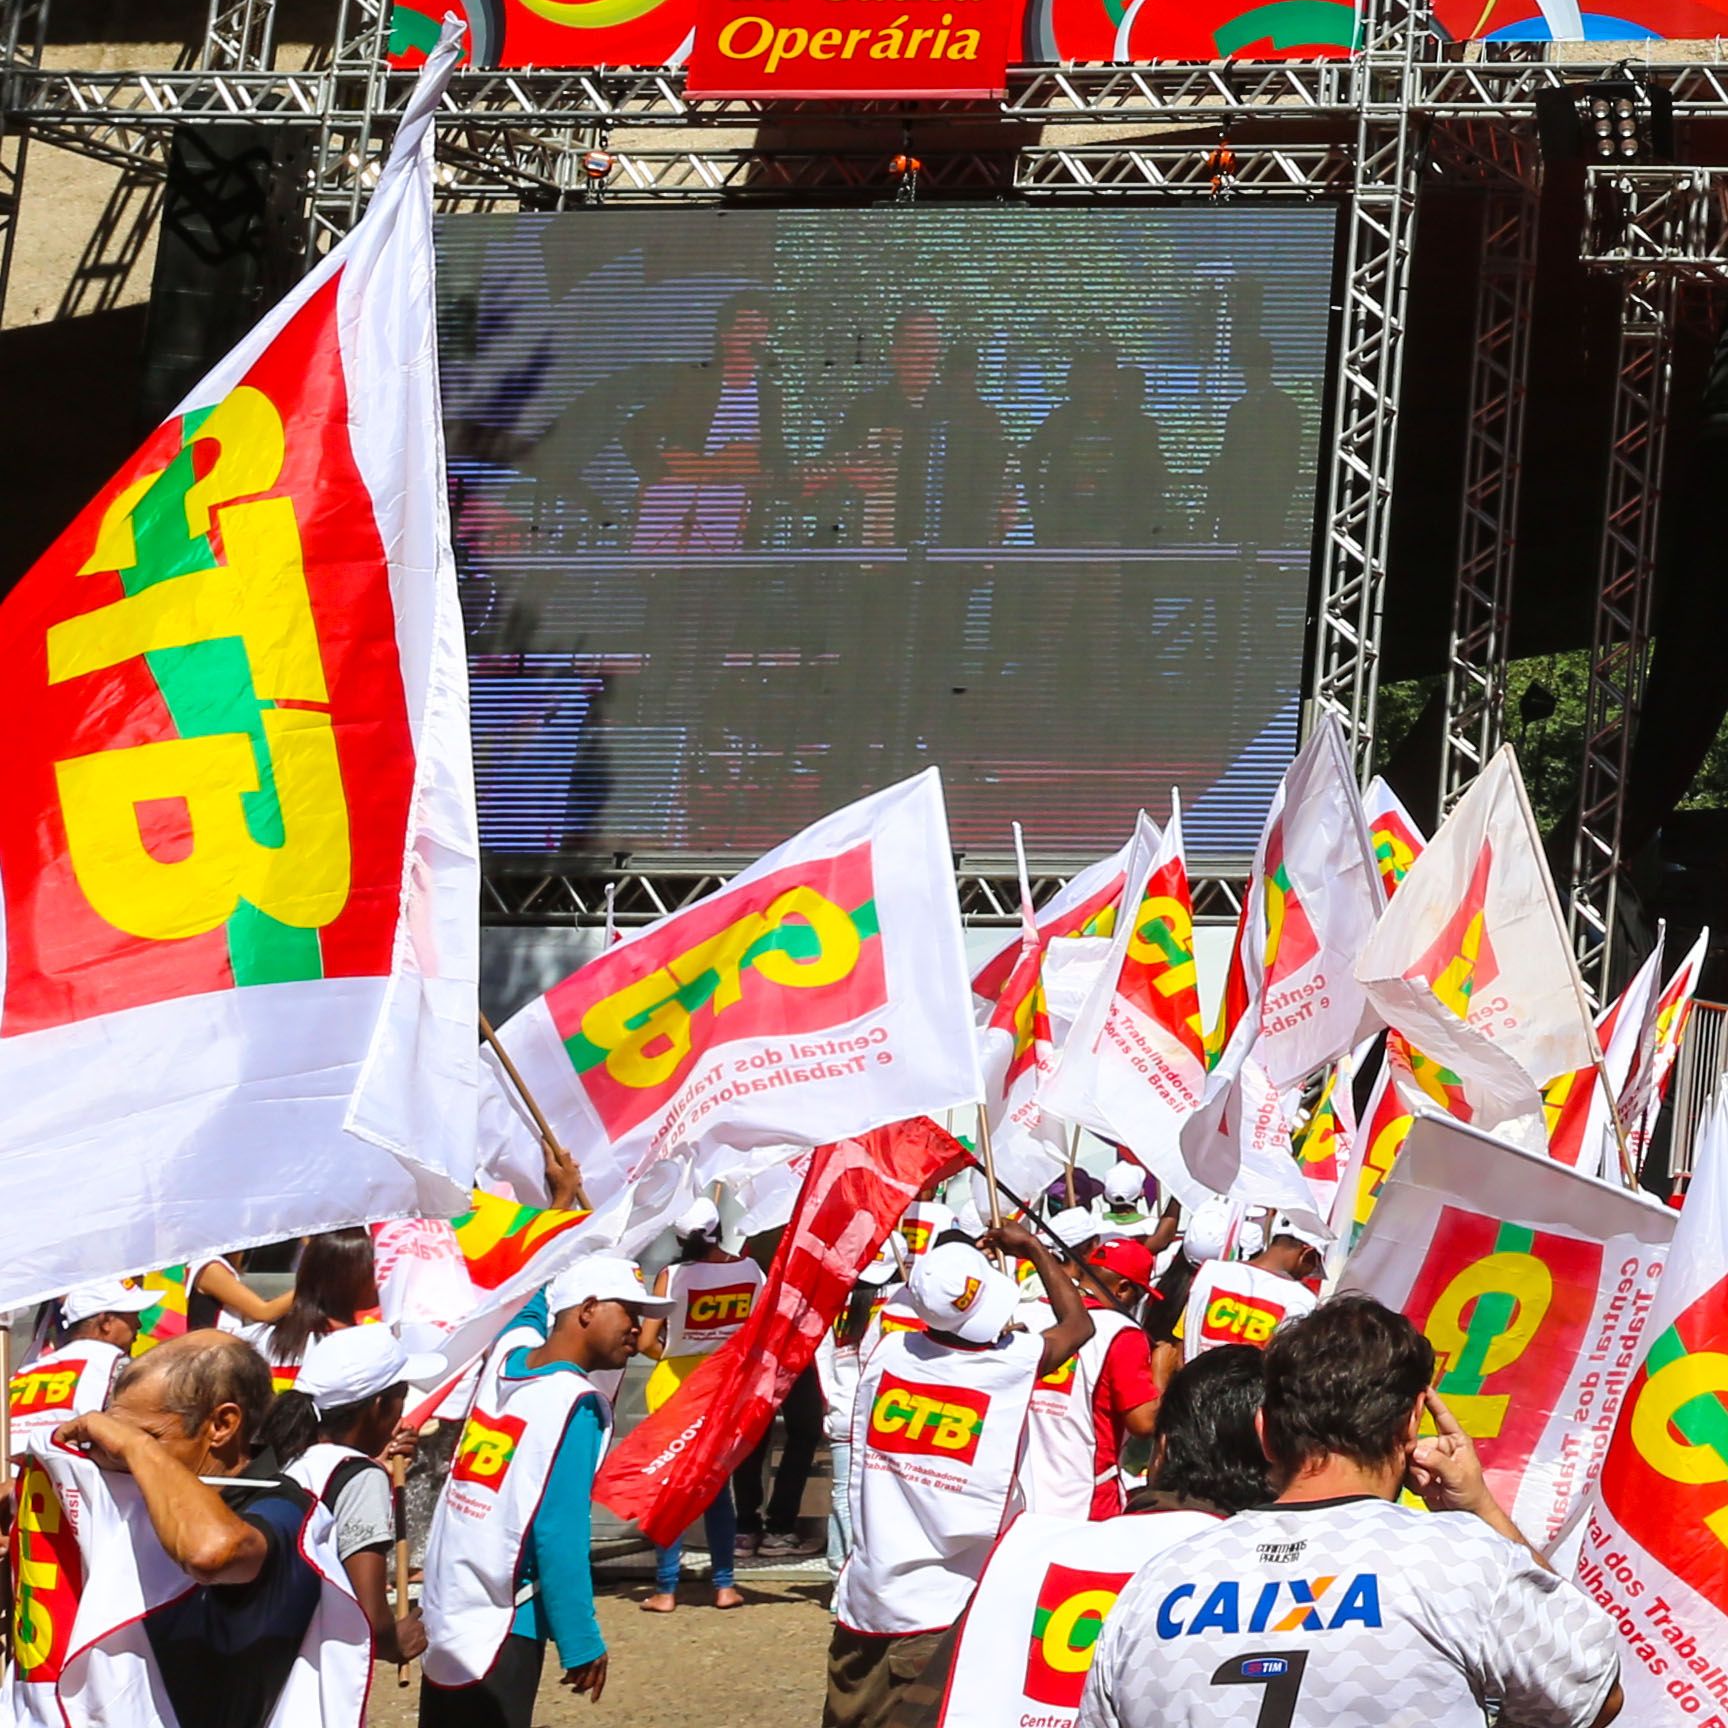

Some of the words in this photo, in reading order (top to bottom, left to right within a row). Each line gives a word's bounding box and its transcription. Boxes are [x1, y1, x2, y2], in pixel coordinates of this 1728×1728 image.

[718, 12, 980, 73] Operária
[46, 385, 352, 940] CTB
[1147, 1074, 1186, 1115] Brasil
[689, 1292, 752, 1323] CTB
[1206, 1296, 1278, 1342] CTB
[872, 1388, 979, 1450] CTB
[14, 1470, 61, 1670] CTB
[1603, 1551, 1646, 1599] dos
[1156, 1573, 1384, 1641] CAIXA
[1262, 1661, 1284, 1674] TIM
[1666, 1676, 1703, 1716] do
